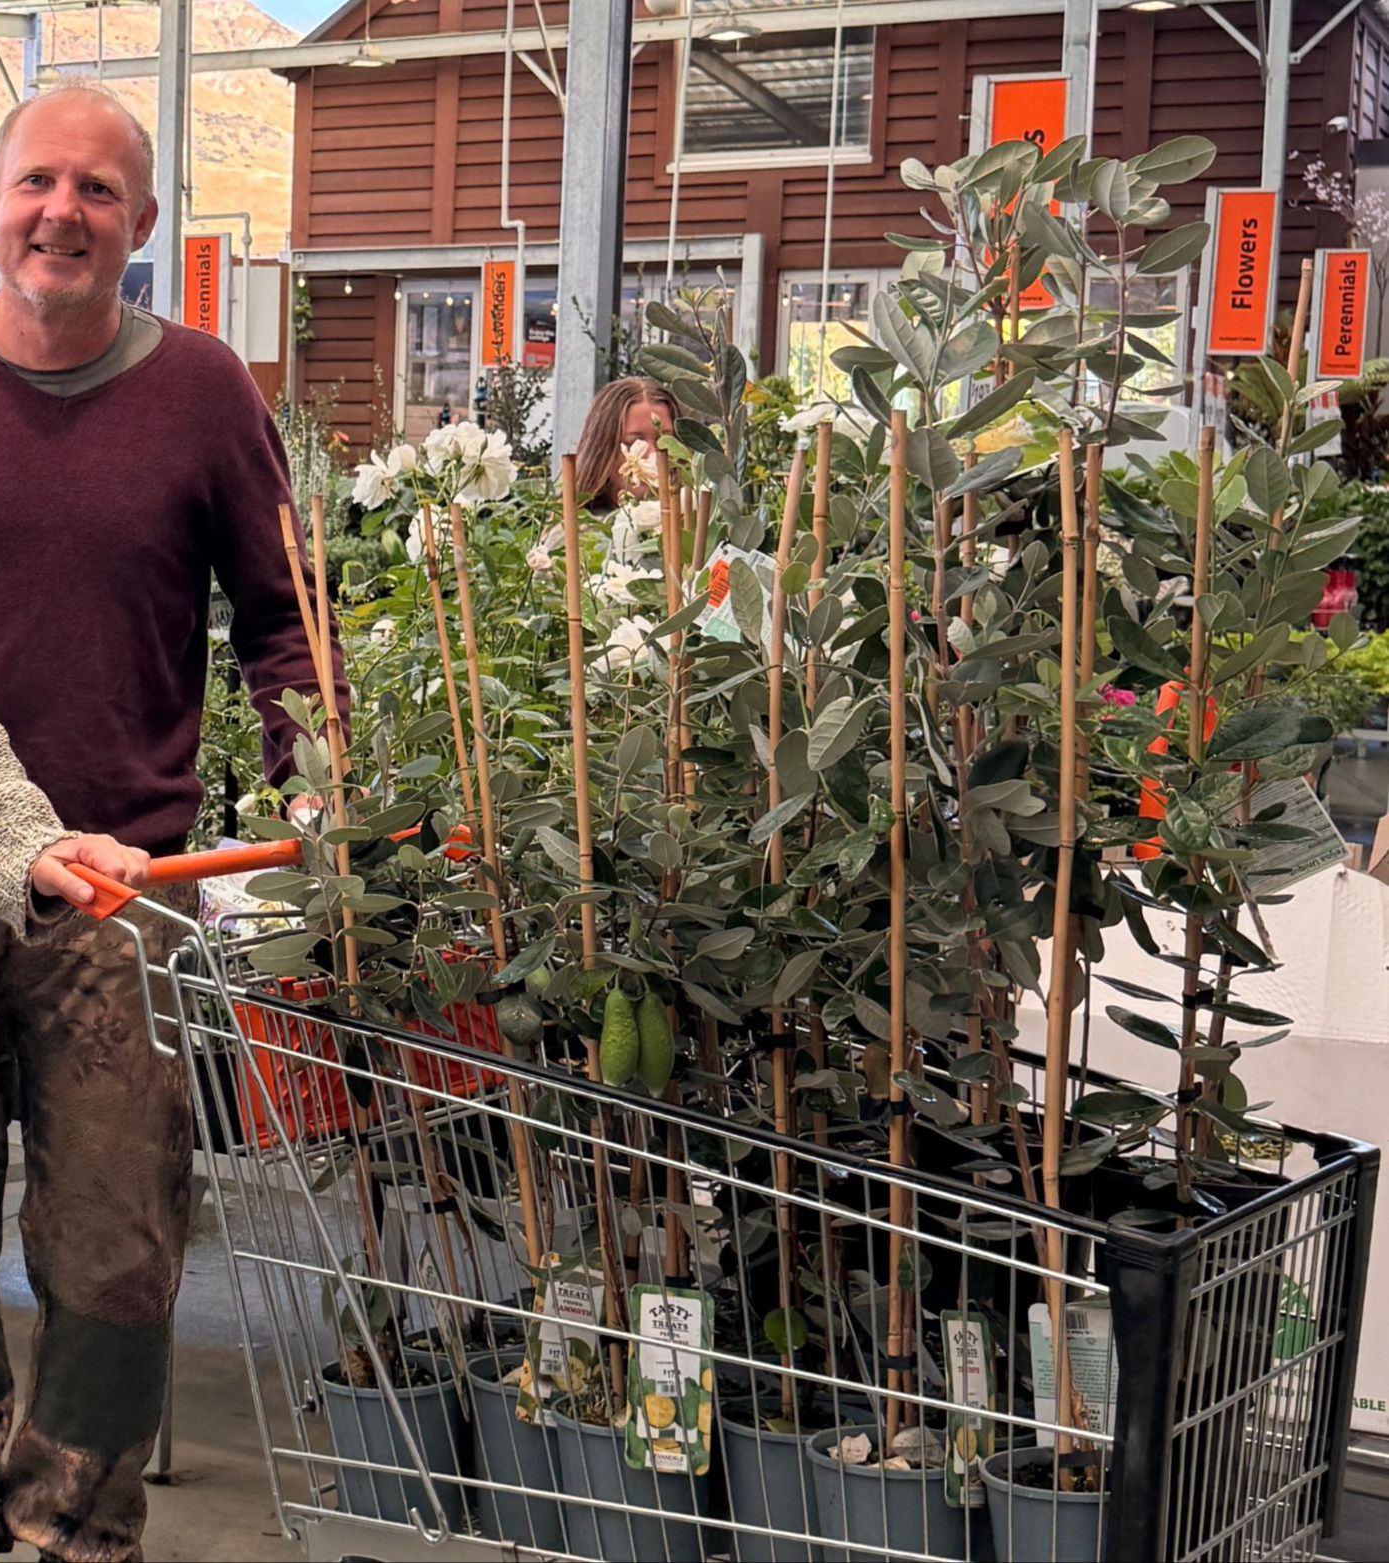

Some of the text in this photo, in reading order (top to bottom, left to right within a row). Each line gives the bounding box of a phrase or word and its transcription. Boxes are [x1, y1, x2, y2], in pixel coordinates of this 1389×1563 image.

[1231, 217, 1258, 310] Flowers
[196, 243, 211, 332] erennials
[491, 271, 506, 346] Lavenders
[1335, 259, 1357, 357] Perennials
[554, 1304, 592, 1317] AMMOTH
[649, 1304, 693, 1321] TASTY
[953, 1330, 978, 1345] TATY
[956, 1347, 978, 1357] TRATS
